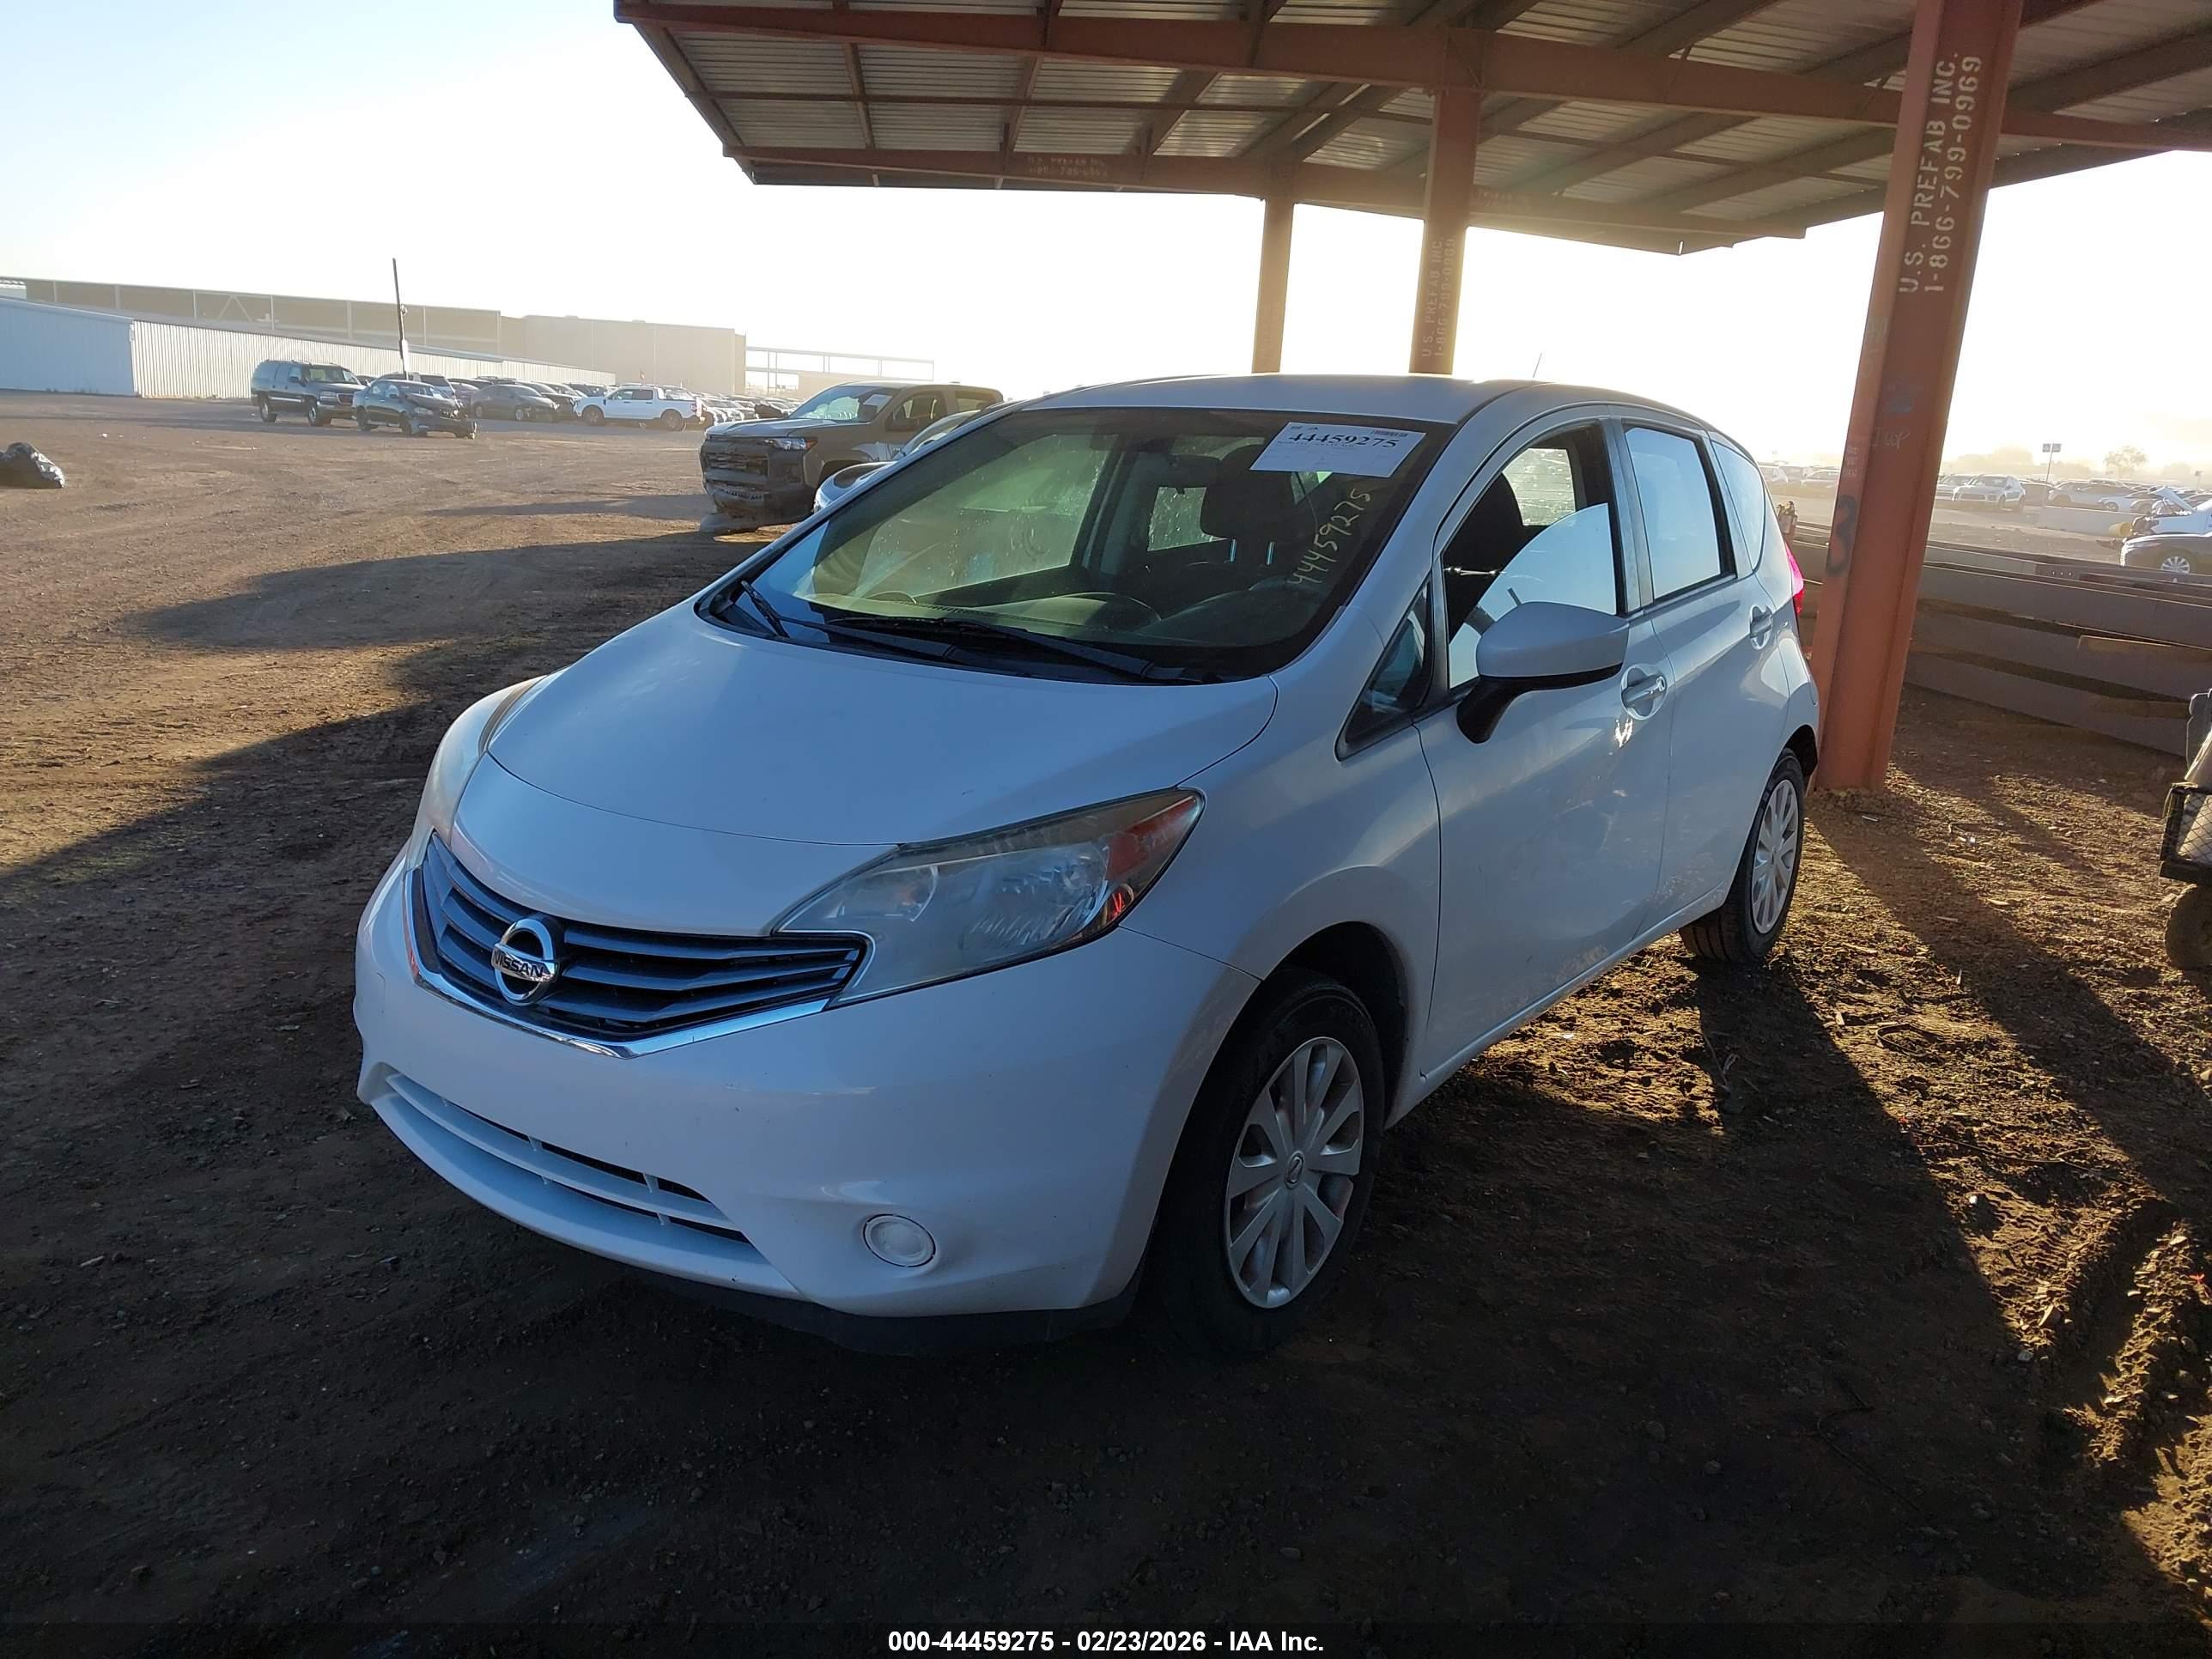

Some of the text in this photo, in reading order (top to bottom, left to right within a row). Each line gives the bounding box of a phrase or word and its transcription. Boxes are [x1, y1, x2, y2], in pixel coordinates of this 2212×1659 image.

[1899, 52, 1960, 293] U.S. PREFAB INC.
[1925, 55, 1982, 293] 1-866-799-0969
[1290, 432, 1401, 449] 44459275
[1288, 488, 1371, 584] 44459275
[493, 949, 544, 977] NISSAN
